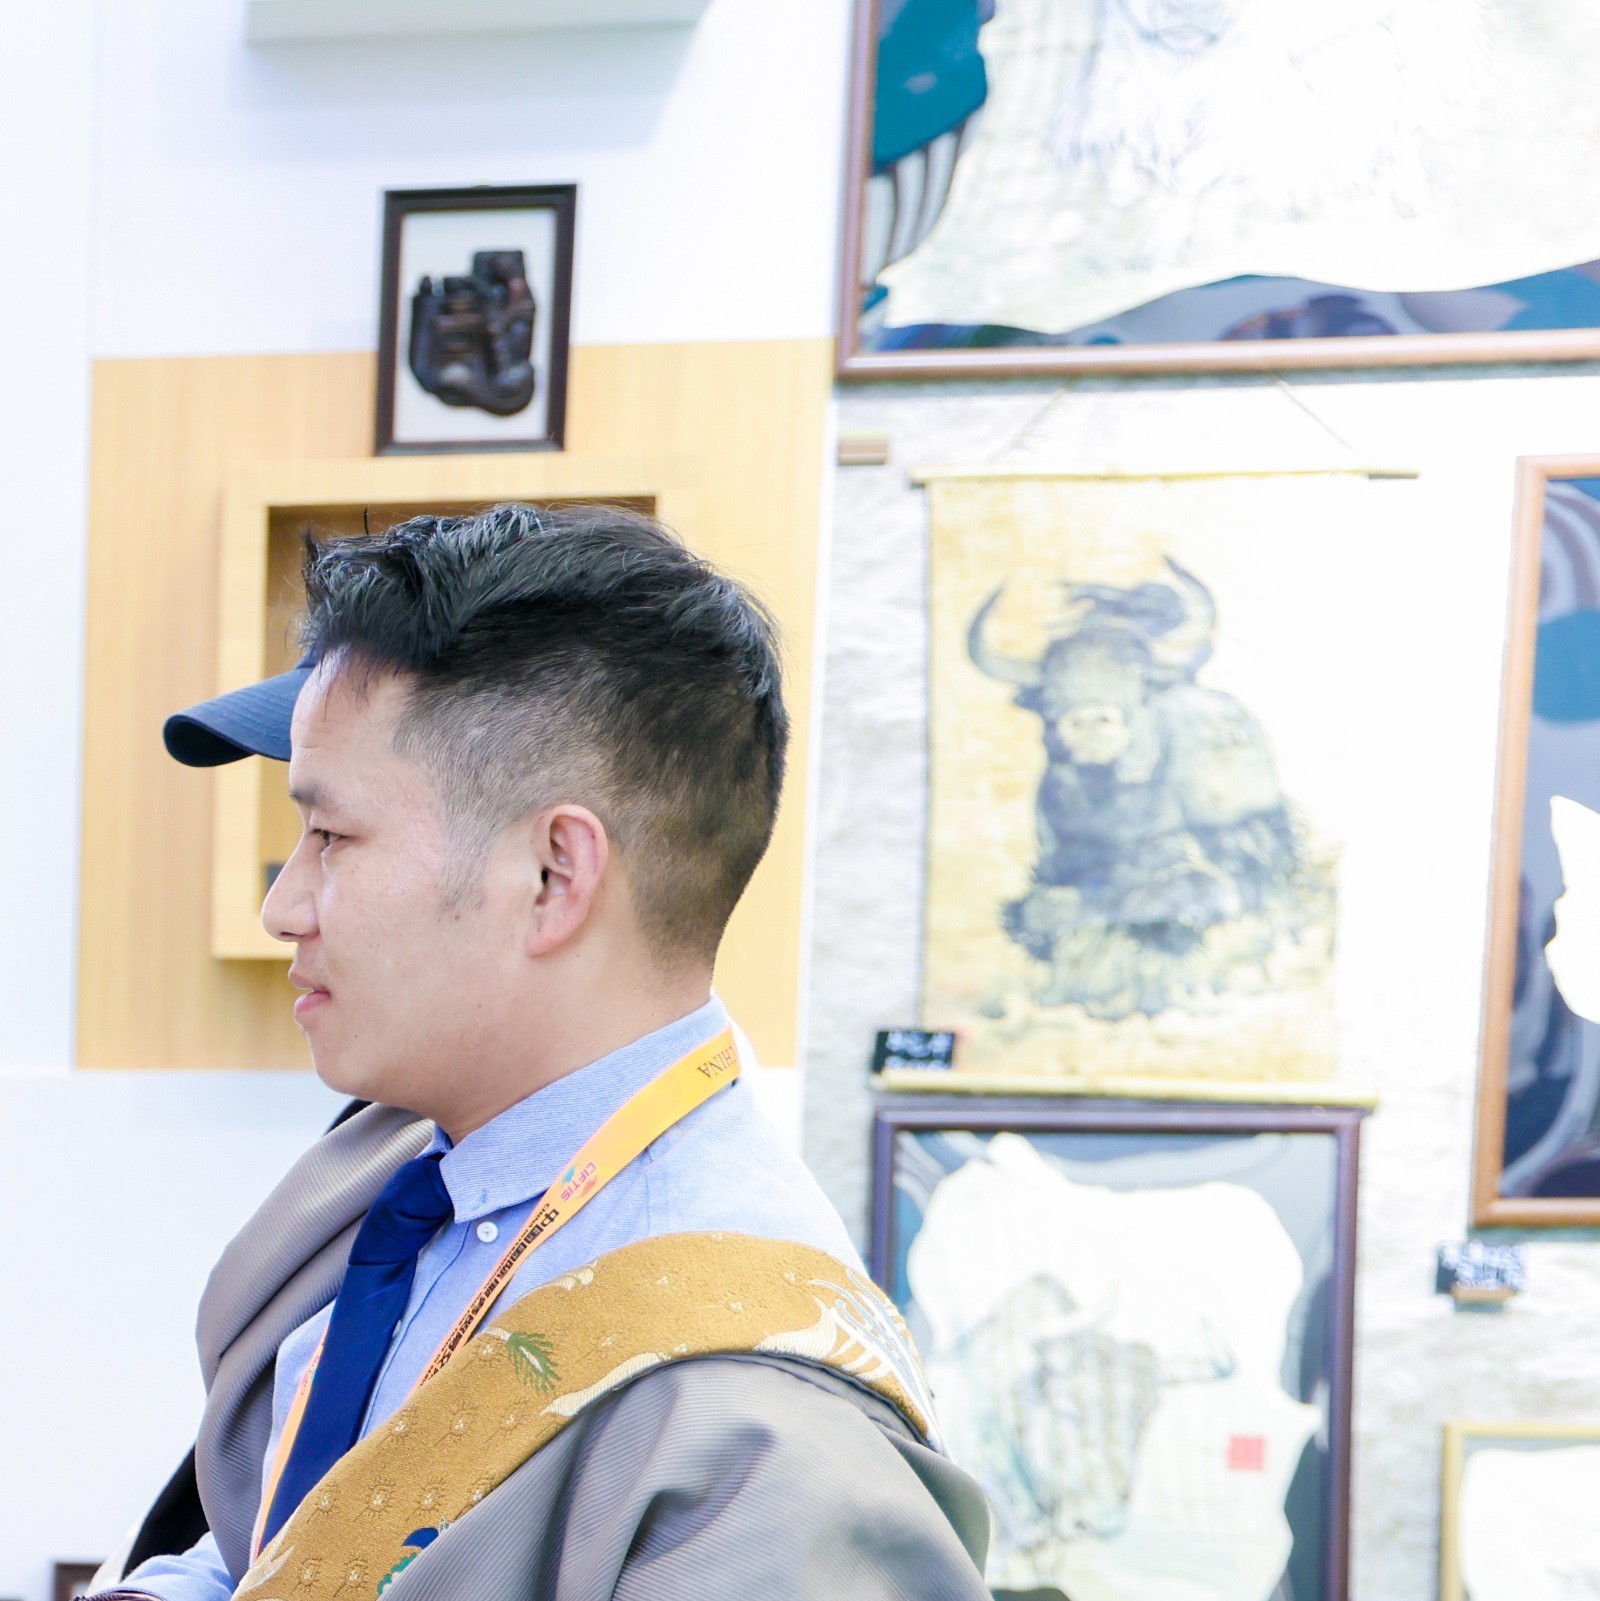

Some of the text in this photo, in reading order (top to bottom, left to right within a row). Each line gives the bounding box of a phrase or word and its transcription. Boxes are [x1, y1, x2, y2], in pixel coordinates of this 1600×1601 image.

[559, 1161, 597, 1202] CIFTIS
[428, 1208, 559, 1380] 中国国际服务贸易交
